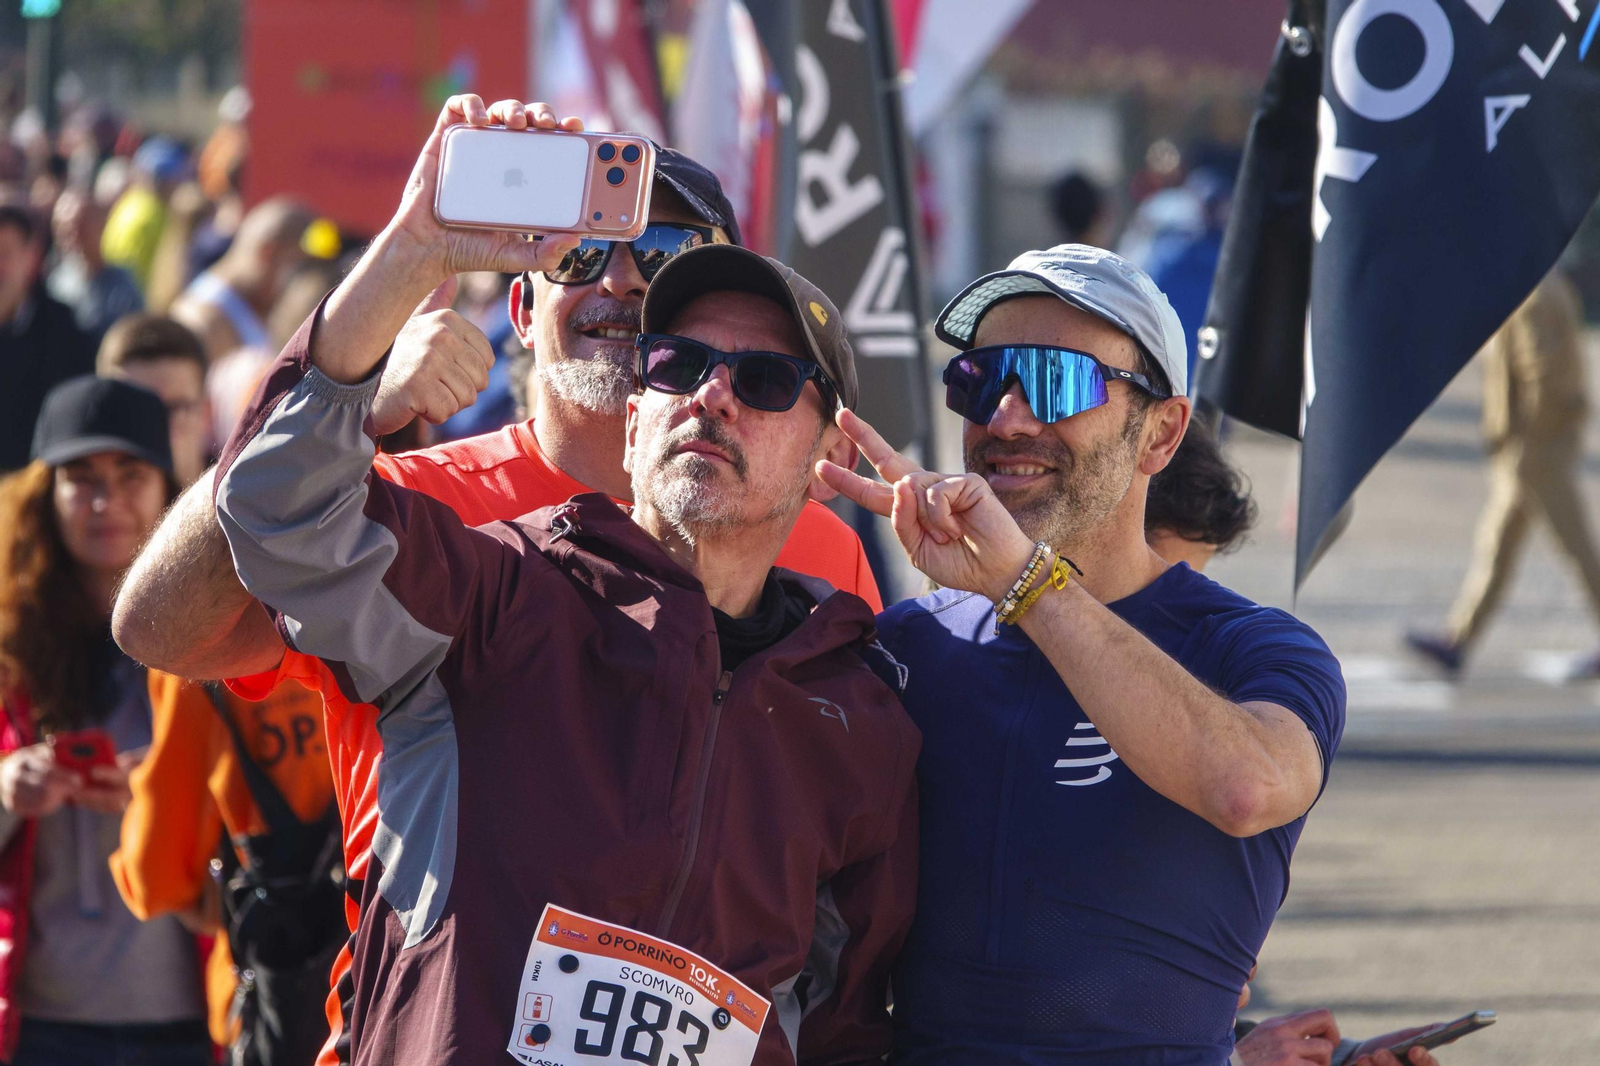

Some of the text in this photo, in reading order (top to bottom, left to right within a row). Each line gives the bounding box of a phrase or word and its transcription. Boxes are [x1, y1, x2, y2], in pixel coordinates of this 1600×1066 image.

[531, 960, 543, 982] 10KM
[613, 935, 686, 970] PORRIÑO
[619, 966, 694, 1006] SCOMVRO
[573, 979, 710, 1066] 983
